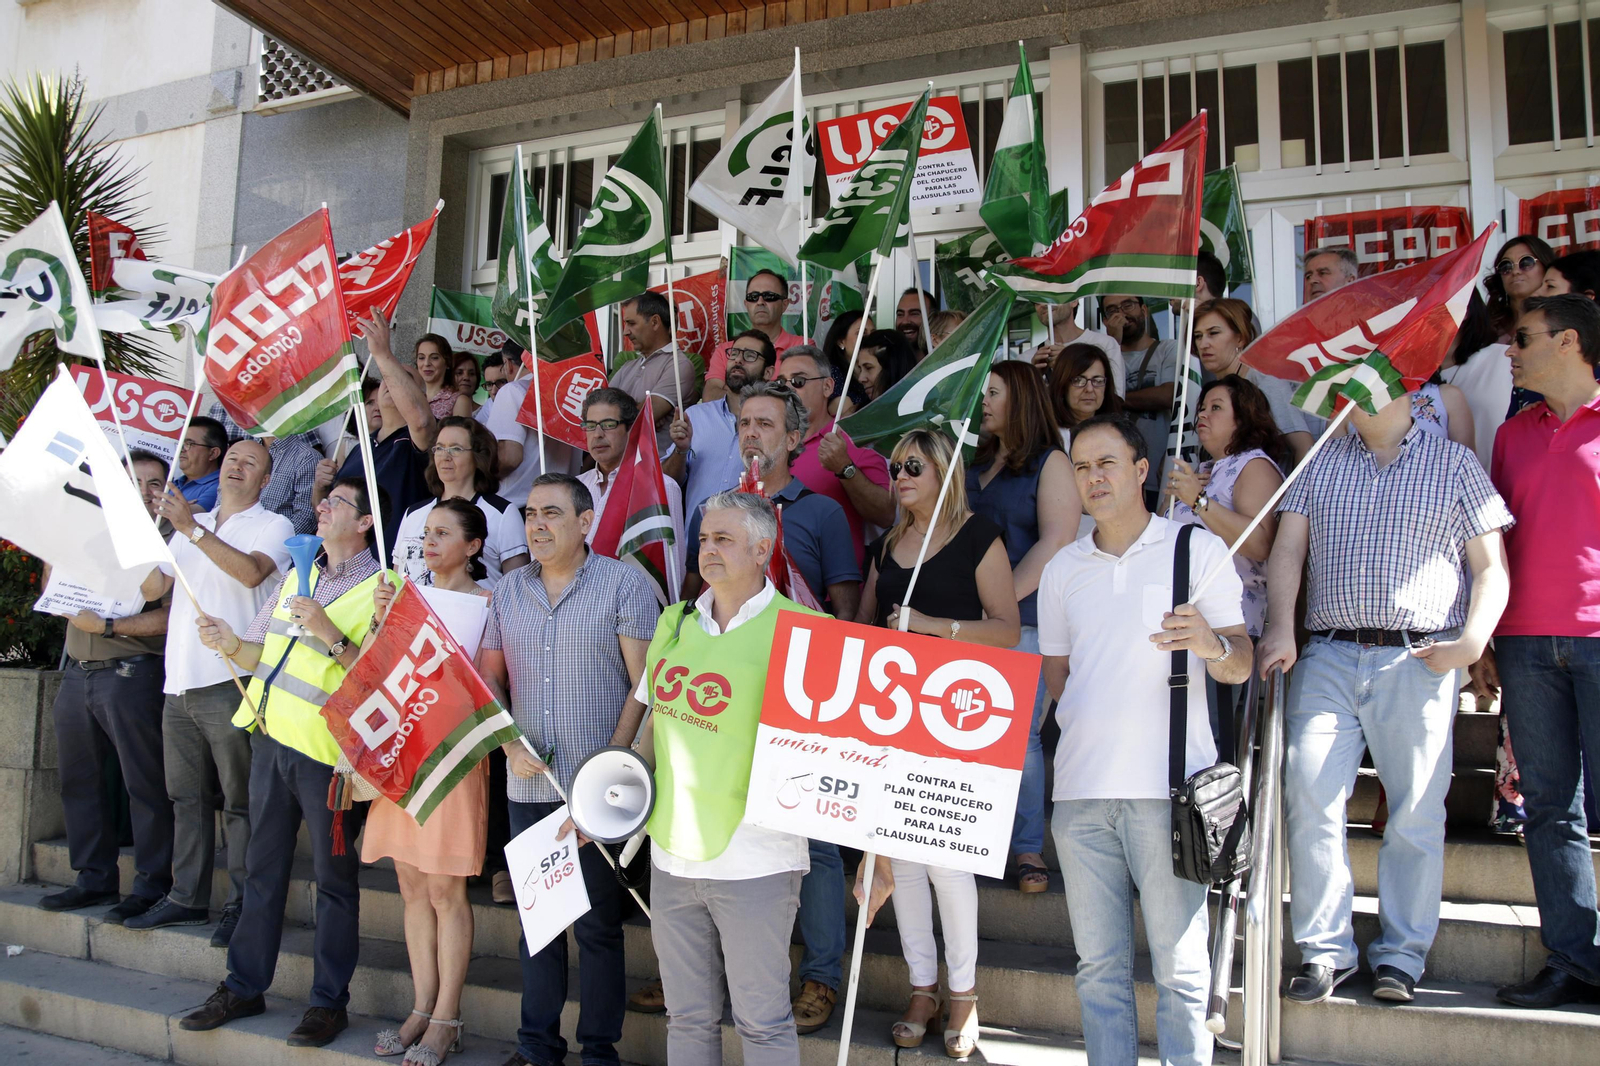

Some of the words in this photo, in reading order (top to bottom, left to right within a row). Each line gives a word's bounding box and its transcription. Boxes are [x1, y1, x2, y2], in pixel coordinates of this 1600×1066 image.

[918, 163, 945, 171] CONTRA
[927, 167, 967, 177] CHAPUCERO
[931, 175, 962, 183] CONSEJO
[912, 191, 951, 201] CLAUSULAS
[953, 188, 974, 196] SUELO
[457, 324, 506, 349] USO
[137, 440, 161, 452] CONTRA
[784, 626, 1014, 751] USO
[680, 712, 719, 733] OBRERA
[818, 776, 860, 799] SPJ
[907, 773, 956, 789] CONTRA
[960, 782, 974, 793] EL
[884, 783, 915, 797] PLAN
[919, 790, 993, 811] CHAPUCERO
[816, 798, 858, 822] USO
[894, 800, 917, 812] DEL
[920, 805, 977, 824] CONSEJO
[904, 817, 935, 831] PARA
[939, 824, 962, 836] LAS
[875, 827, 946, 848] CLAUSULAS
[949, 841, 990, 857] SUELO
[540, 844, 570, 874] SPJ
[544, 862, 575, 890] USO
